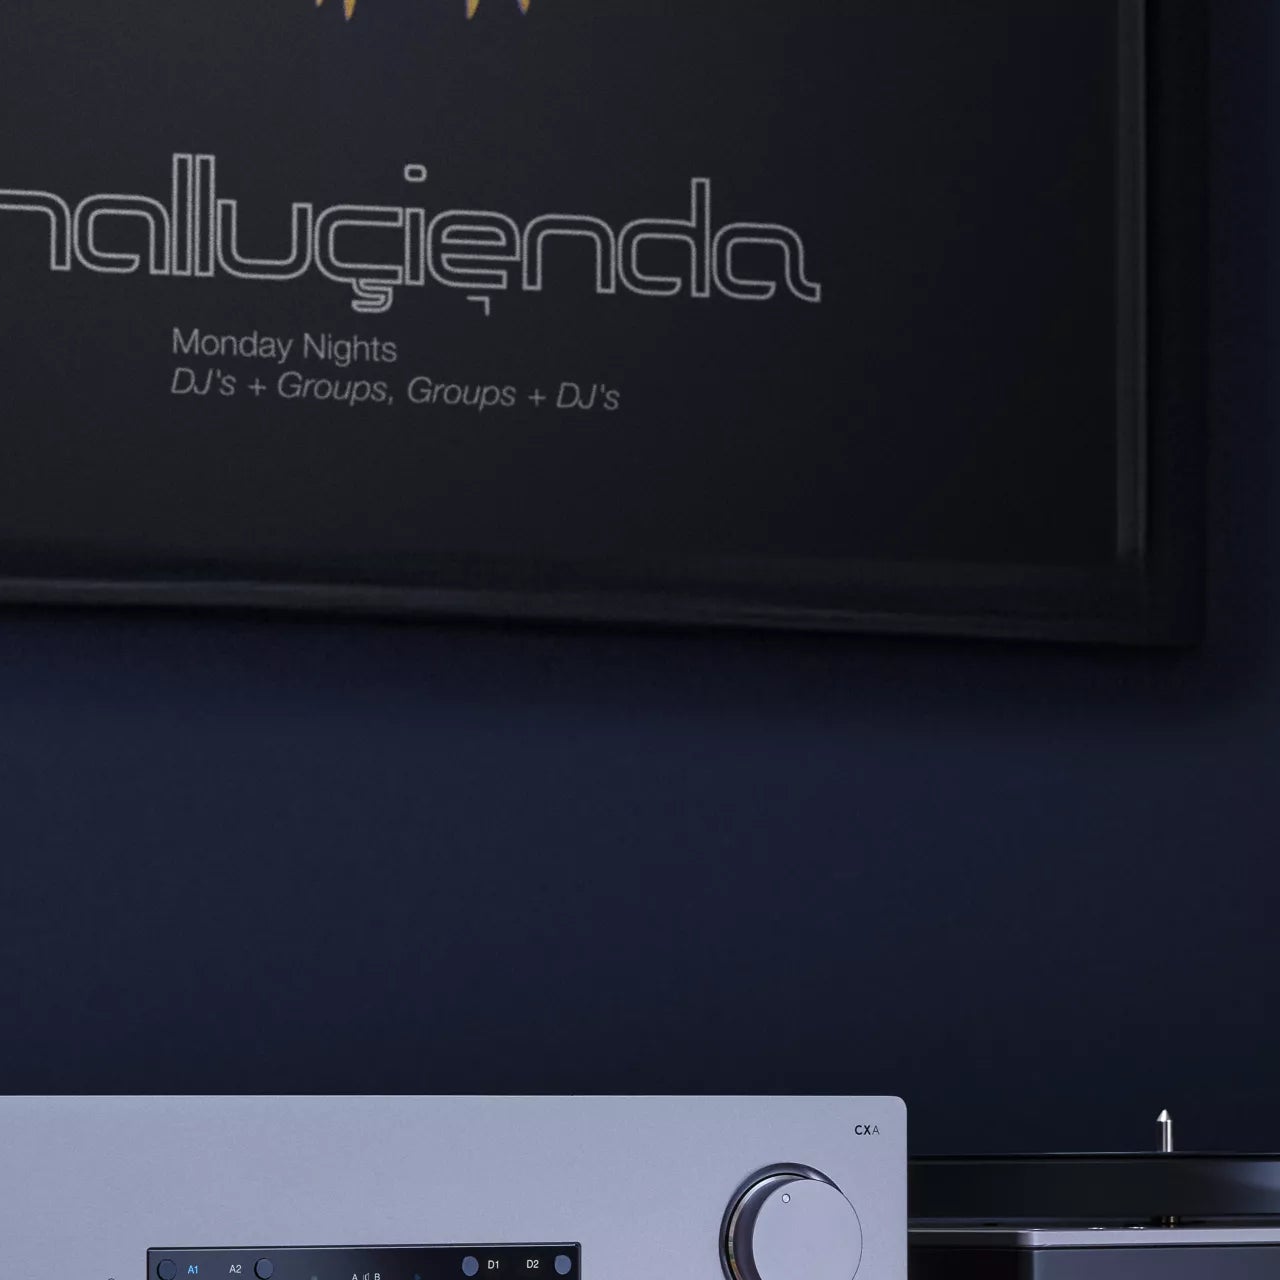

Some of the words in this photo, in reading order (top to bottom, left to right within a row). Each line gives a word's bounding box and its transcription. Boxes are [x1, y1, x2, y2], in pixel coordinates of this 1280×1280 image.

[173, 328, 292, 364] Monday
[304, 333, 396, 366] Nights
[171, 368, 236, 396] DJ's
[248, 379, 267, 396] +
[277, 373, 394, 405] Groups,
[407, 376, 515, 411] Groups
[528, 389, 546, 405] +
[556, 382, 620, 410] DJ's
[854, 1124, 880, 1136] CXA
[187, 1264, 199, 1275] A1
[228, 1264, 242, 1274] A2
[487, 1259, 499, 1270] D1
[526, 1259, 539, 1269] D2
